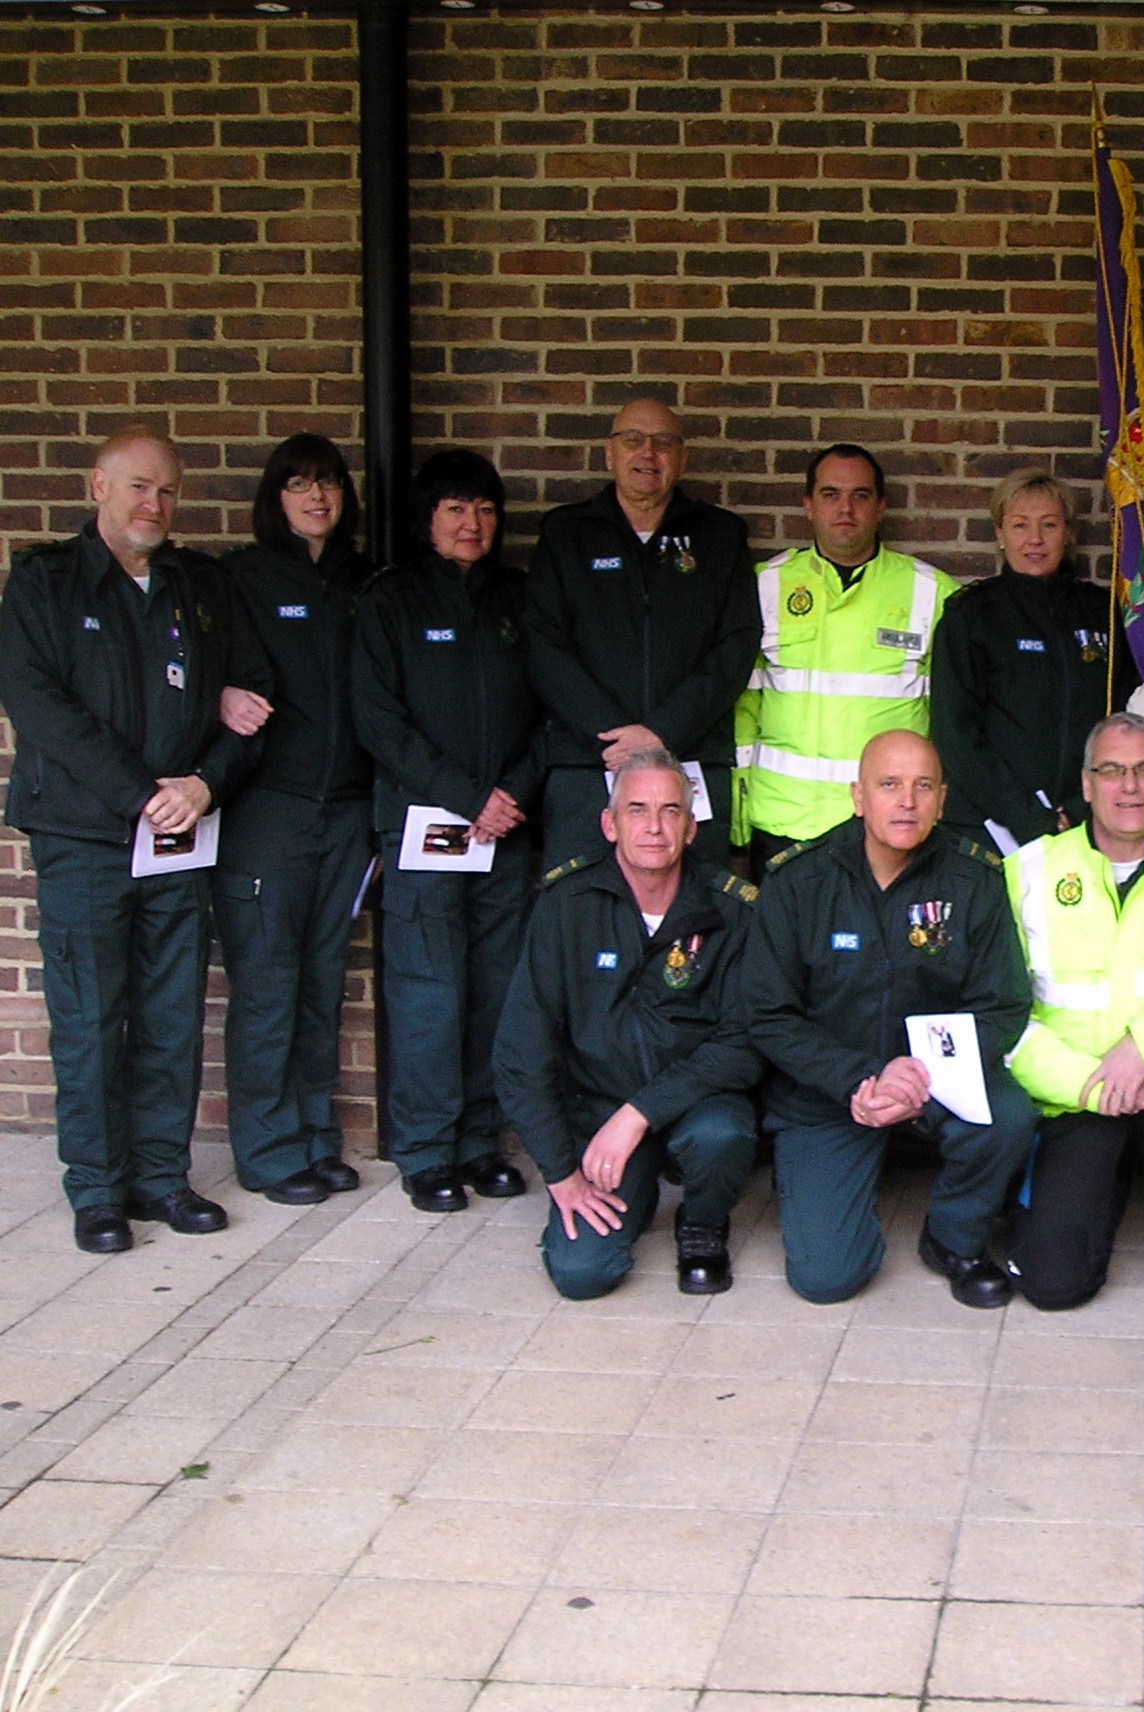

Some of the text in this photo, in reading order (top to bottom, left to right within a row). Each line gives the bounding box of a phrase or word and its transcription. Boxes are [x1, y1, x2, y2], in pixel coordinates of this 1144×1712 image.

[593, 557, 620, 569] NHS
[280, 606, 305, 618] NHS
[427, 630, 453, 642] NHS
[1019, 640, 1045, 652] NHS
